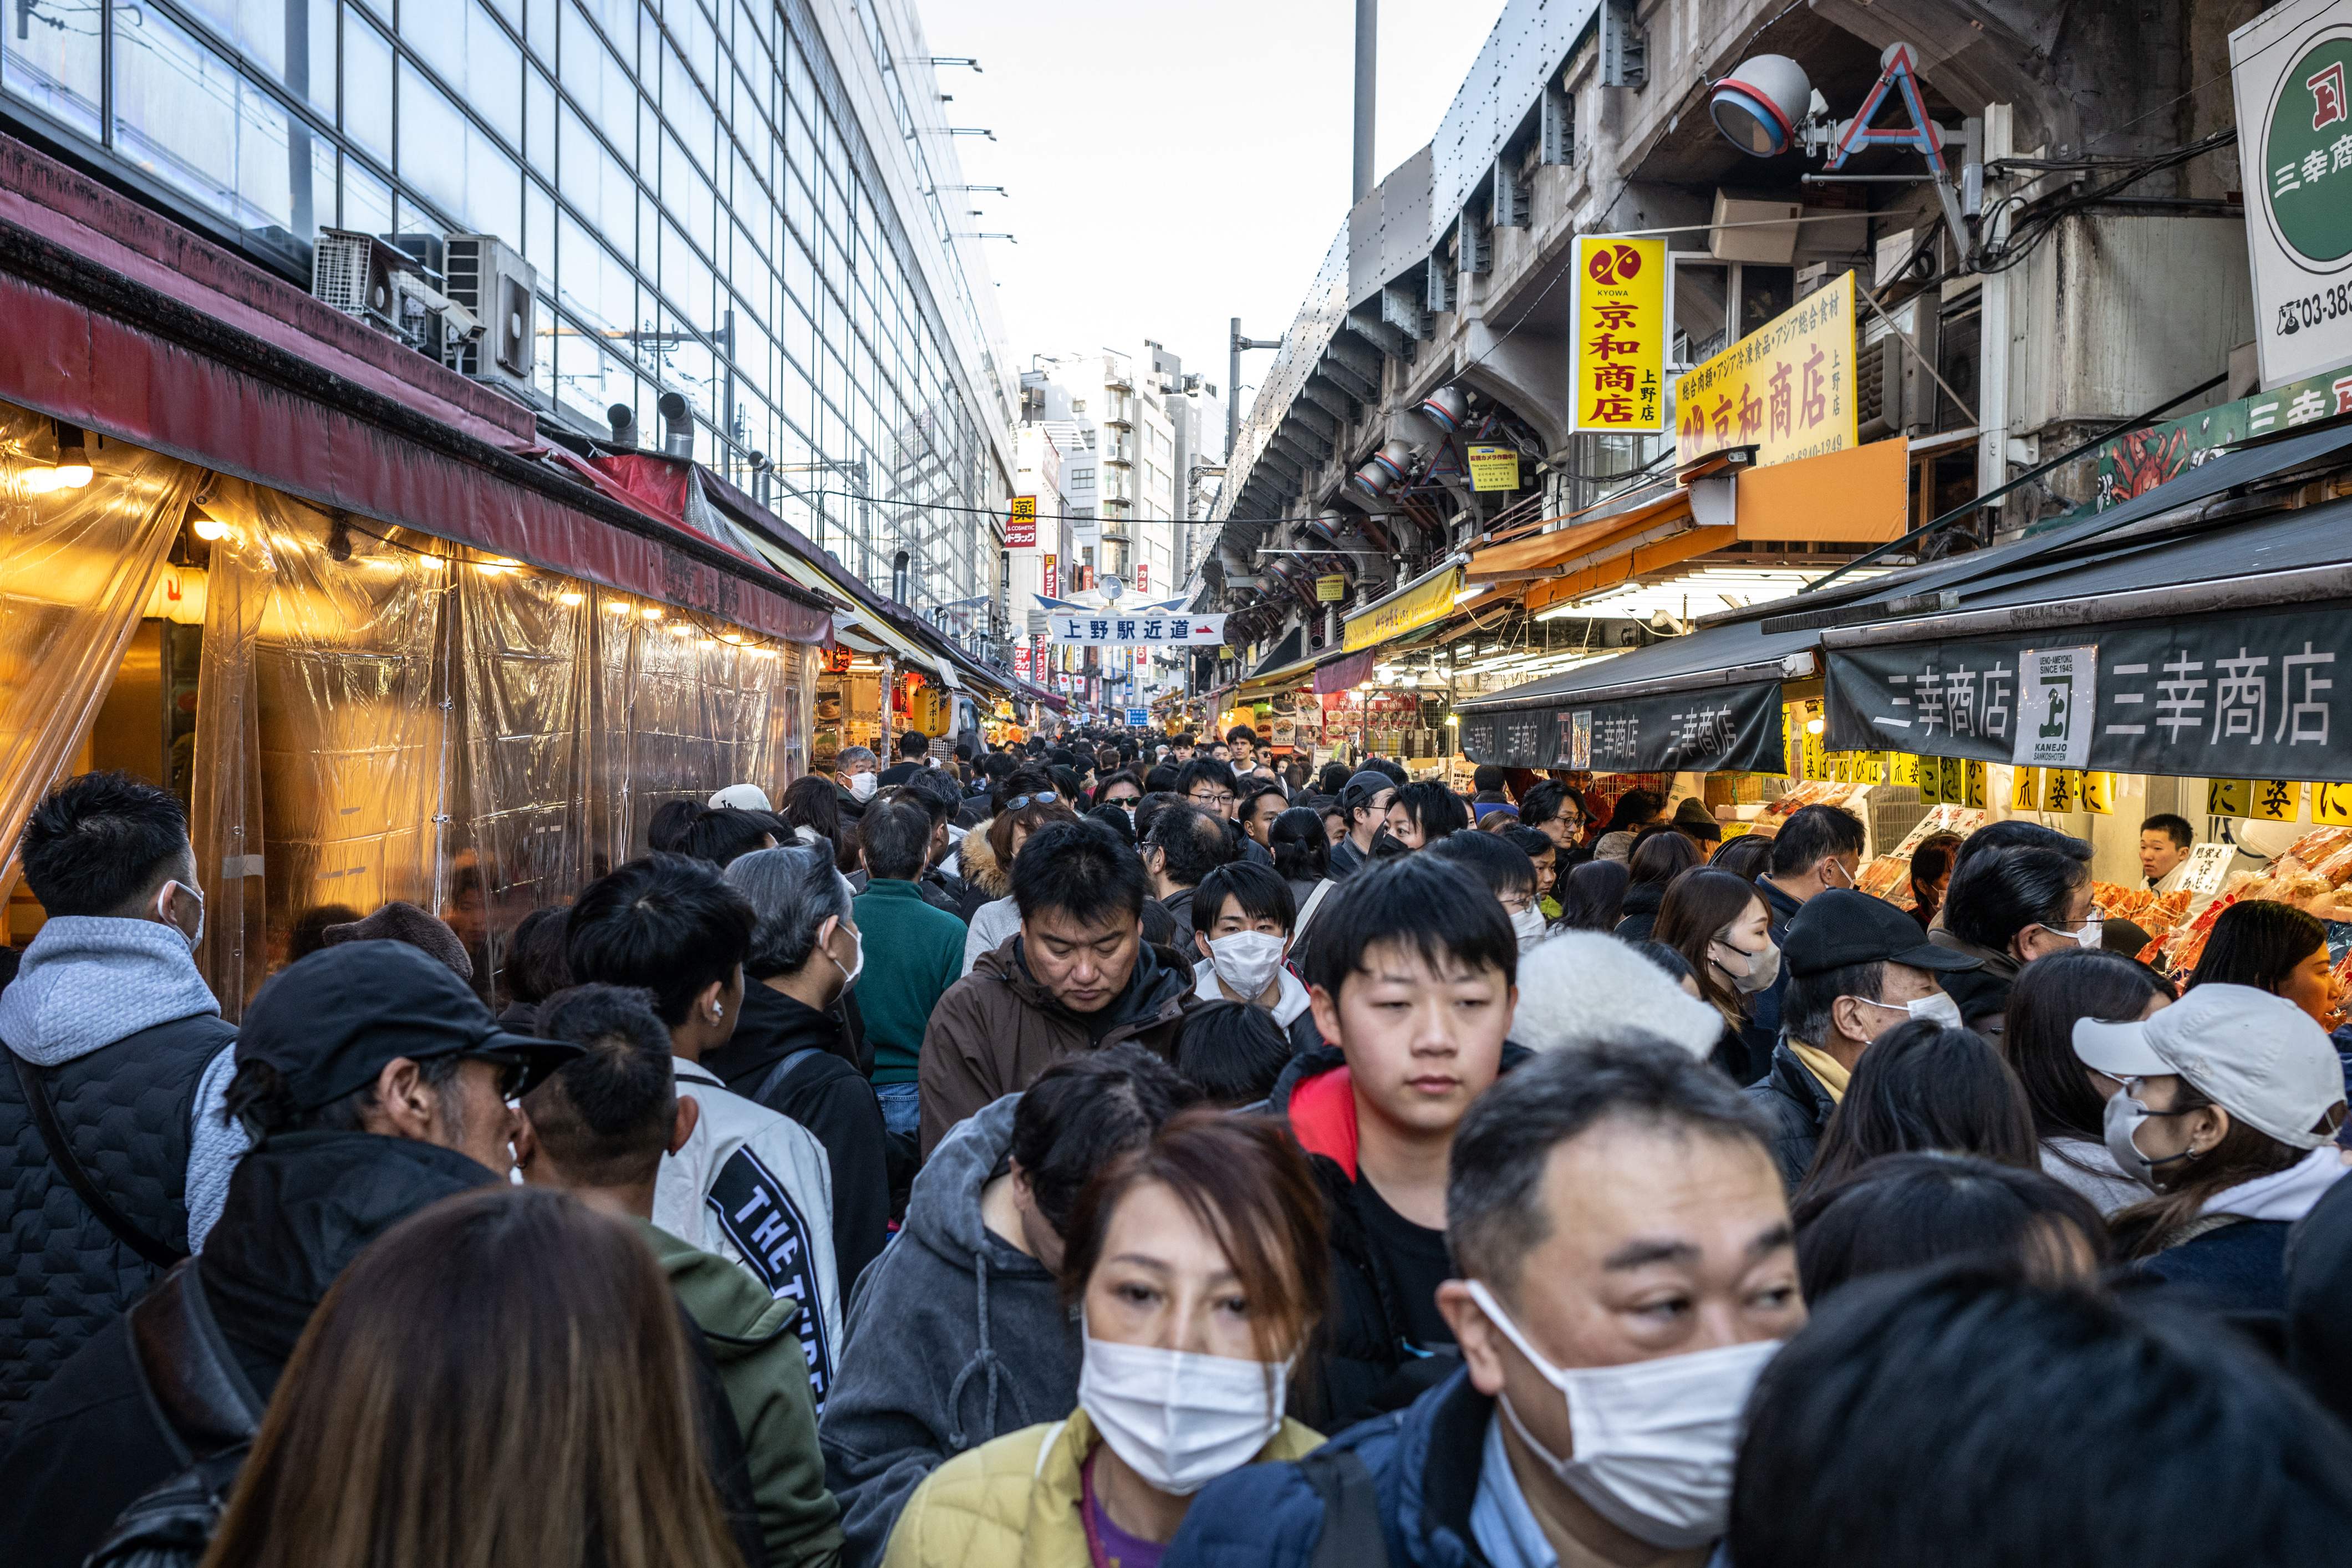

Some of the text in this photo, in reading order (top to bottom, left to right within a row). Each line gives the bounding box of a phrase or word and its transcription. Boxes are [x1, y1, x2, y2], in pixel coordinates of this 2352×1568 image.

[1587, 301, 1640, 423] 京和商店
[1831, 349, 1840, 417] 上野店
[1640, 369, 1657, 421] 上野店
[1710, 343, 1826, 451] 京和商店
[1015, 500, 1032, 521] 薬
[1064, 619, 1190, 640] 上野駅近道
[2040, 664, 2073, 674] SINCE 1945
[929, 693, 937, 731] ハイボール
[1873, 661, 2012, 738] 三幸商店
[2105, 641, 2335, 746] 三幸商店
[1507, 721, 1538, 757] 三幸商店
[1592, 714, 1639, 758] 三幸商店
[1667, 704, 1737, 757] 三幸商店
[2034, 744, 2067, 752] KANEJO
[2033, 752, 2066, 761] SANKOSHOTEN
[2050, 770, 2069, 811] 姿
[734, 1185, 799, 1274] THE
